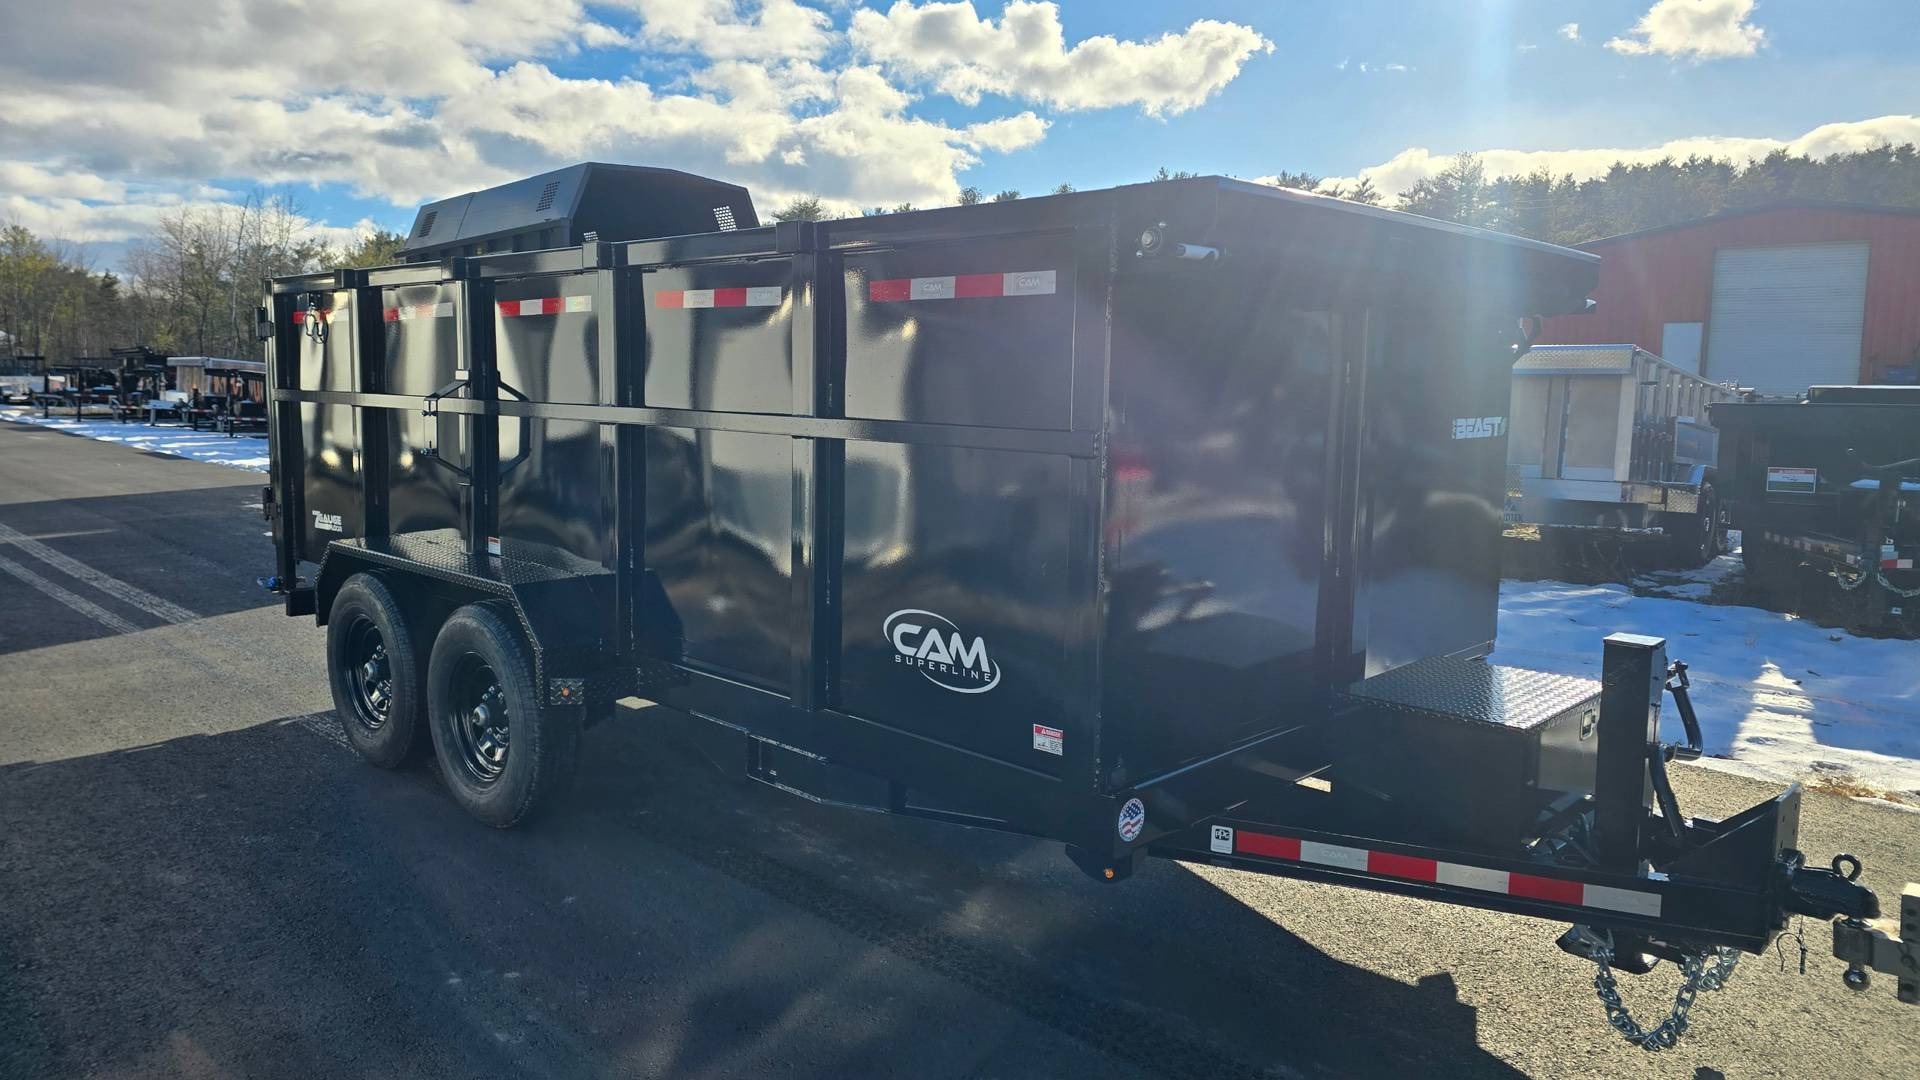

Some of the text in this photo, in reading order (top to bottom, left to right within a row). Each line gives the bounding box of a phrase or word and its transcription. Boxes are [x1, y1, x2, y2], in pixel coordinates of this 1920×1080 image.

[1018, 277, 1040, 287] CAM
[1455, 416, 1503, 439] BEAST
[893, 622, 990, 673] CAM
[894, 654, 992, 682] SUPERLINE
